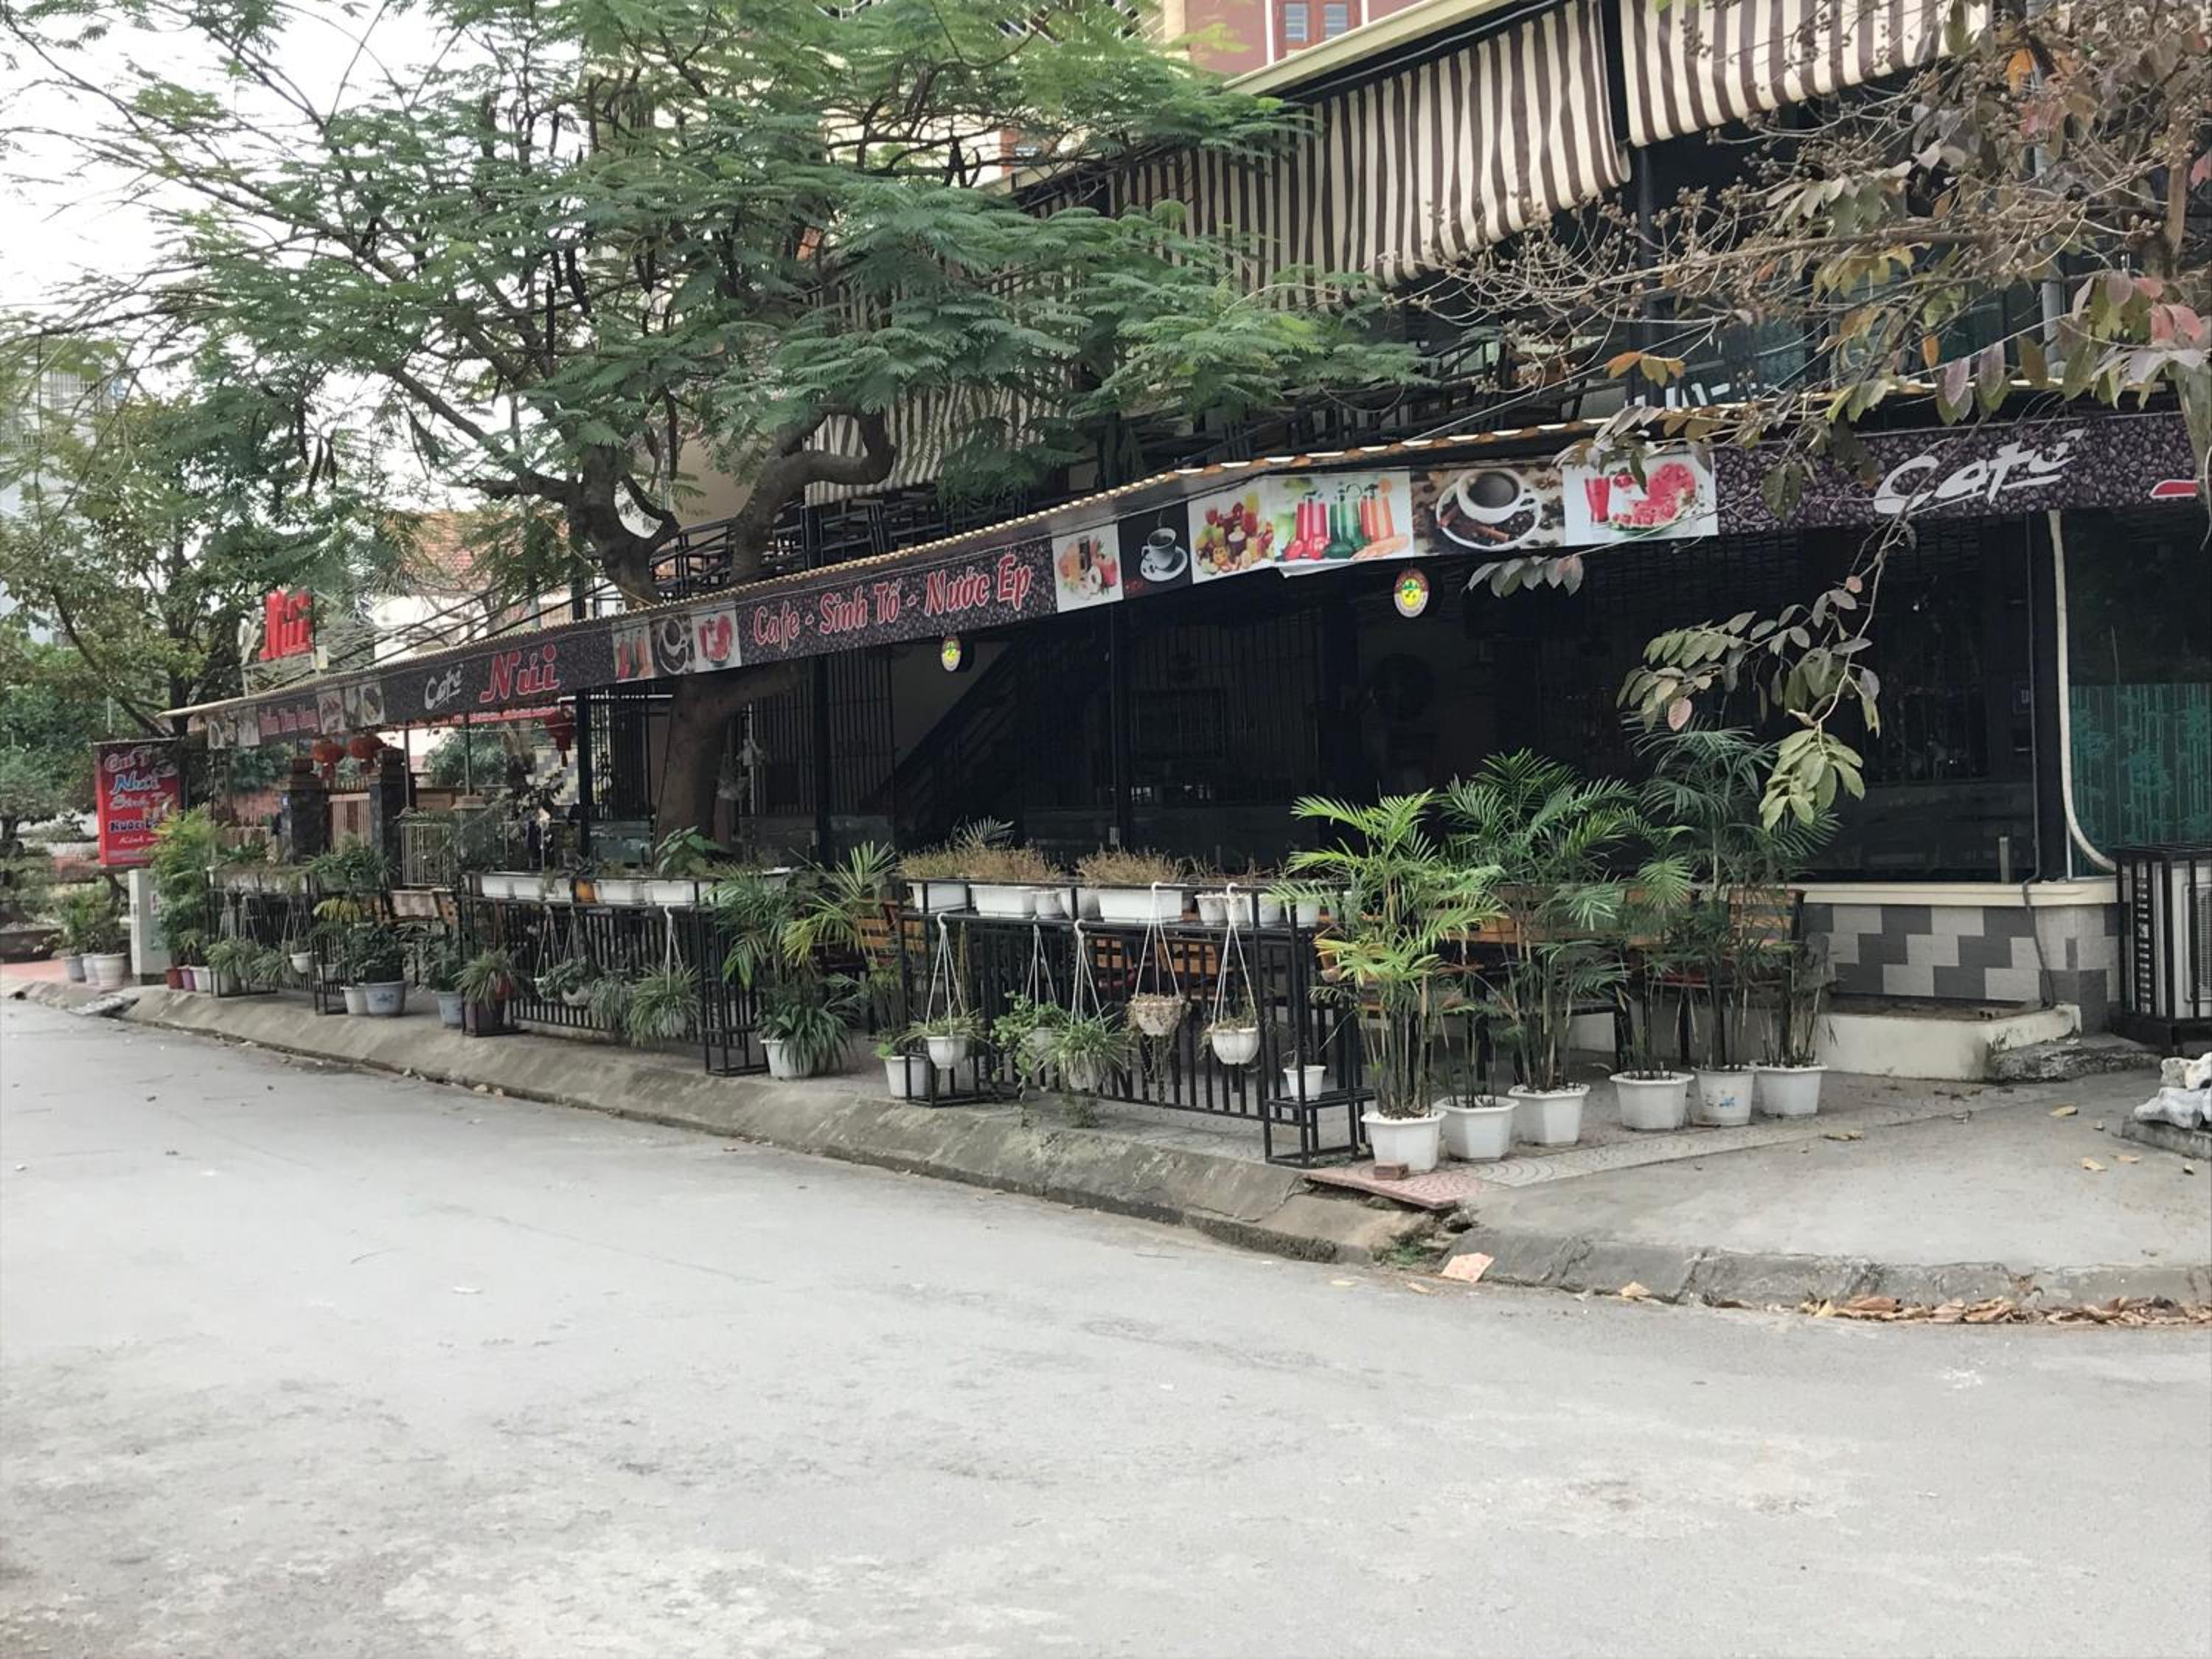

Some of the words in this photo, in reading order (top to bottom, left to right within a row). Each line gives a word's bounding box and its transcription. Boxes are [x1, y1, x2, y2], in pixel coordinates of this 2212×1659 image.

[754, 600, 800, 652] Cafe
[819, 585, 869, 634] Sinh
[873, 578, 902, 625] Tố
[925, 566, 990, 616] Nước
[998, 545, 1032, 611] Ép
[479, 644, 560, 703] Núi
